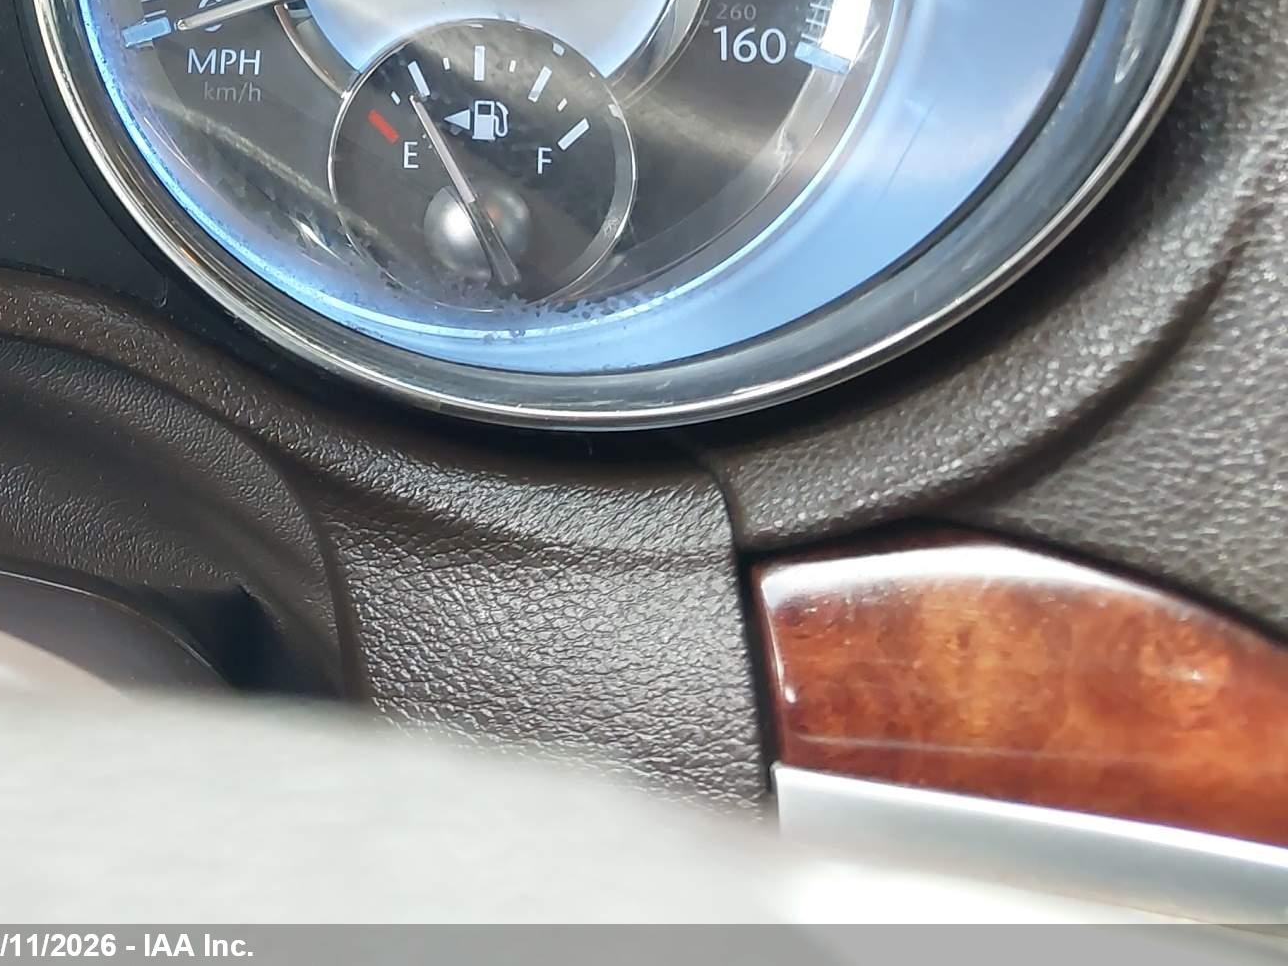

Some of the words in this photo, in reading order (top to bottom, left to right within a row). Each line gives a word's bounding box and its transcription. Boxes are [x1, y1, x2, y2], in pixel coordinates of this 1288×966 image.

[716, 3, 757, 22] 260
[712, 24, 787, 65] 160
[187, 47, 261, 75] MPH
[203, 81, 261, 102] km/h
[403, 141, 419, 169] E
[537, 147, 552, 175] F
